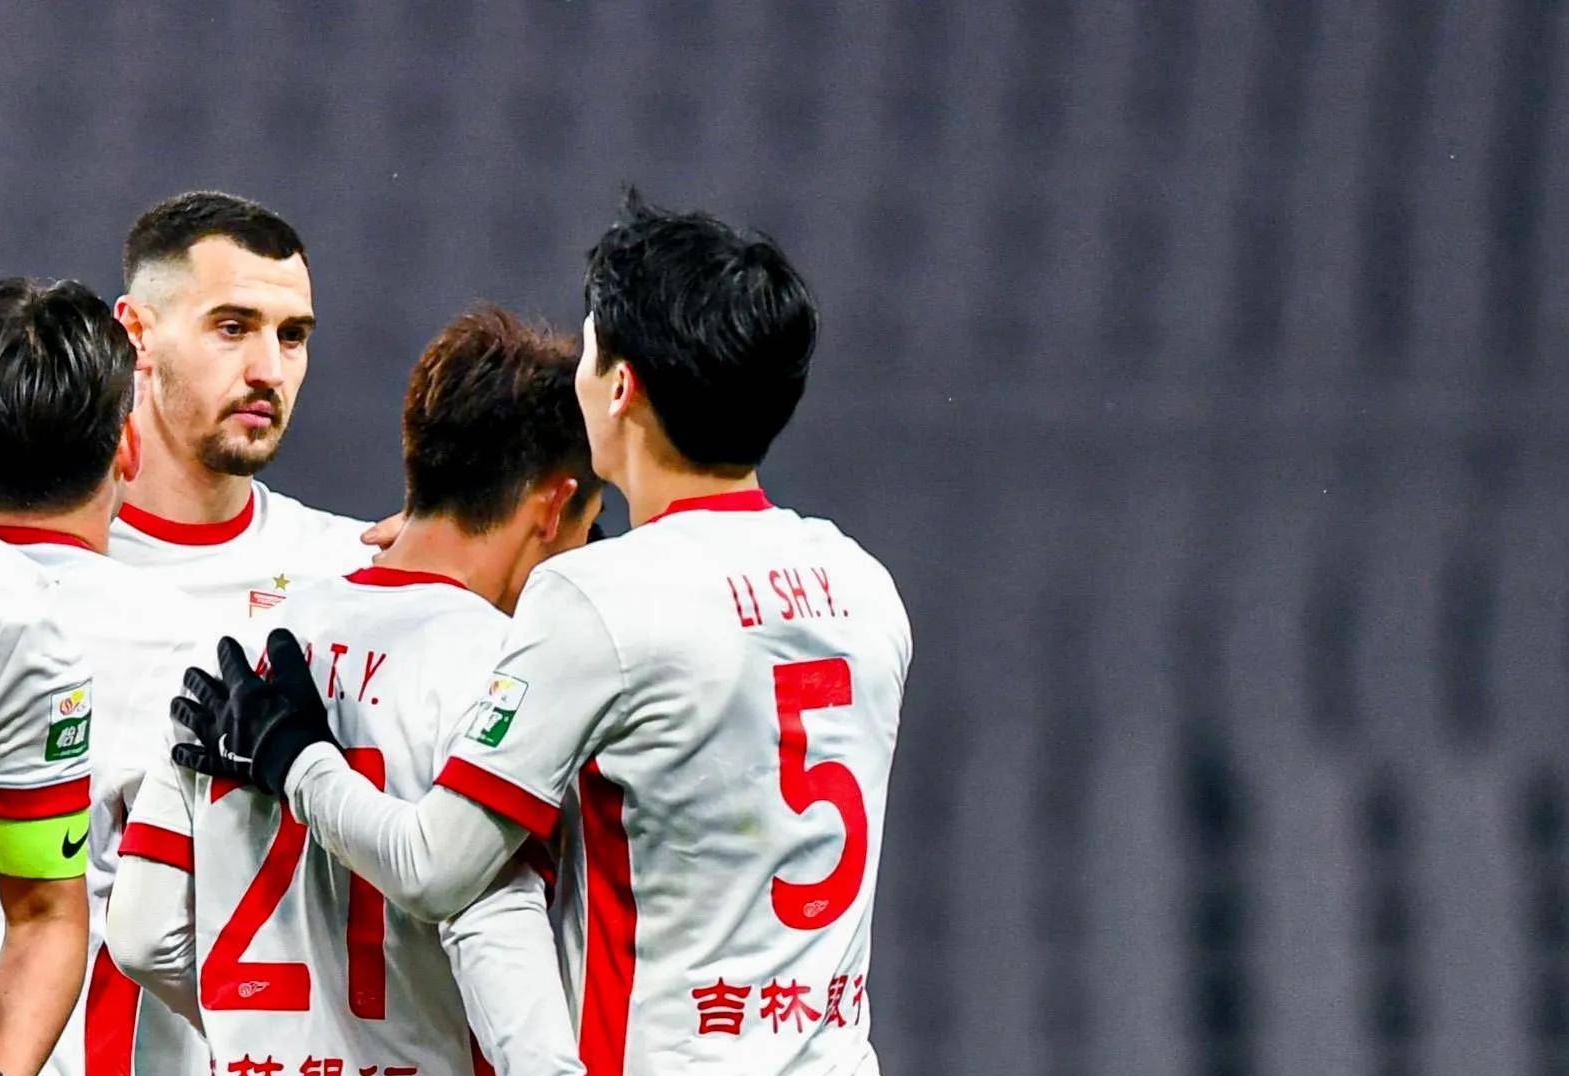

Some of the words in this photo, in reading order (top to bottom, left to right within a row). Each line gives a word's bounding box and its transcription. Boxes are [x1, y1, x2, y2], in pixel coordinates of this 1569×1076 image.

[727, 575, 763, 627] LI
[769, 567, 849, 621] SH.Y.
[201, 747, 386, 1020] 21
[770, 657, 869, 930] 5
